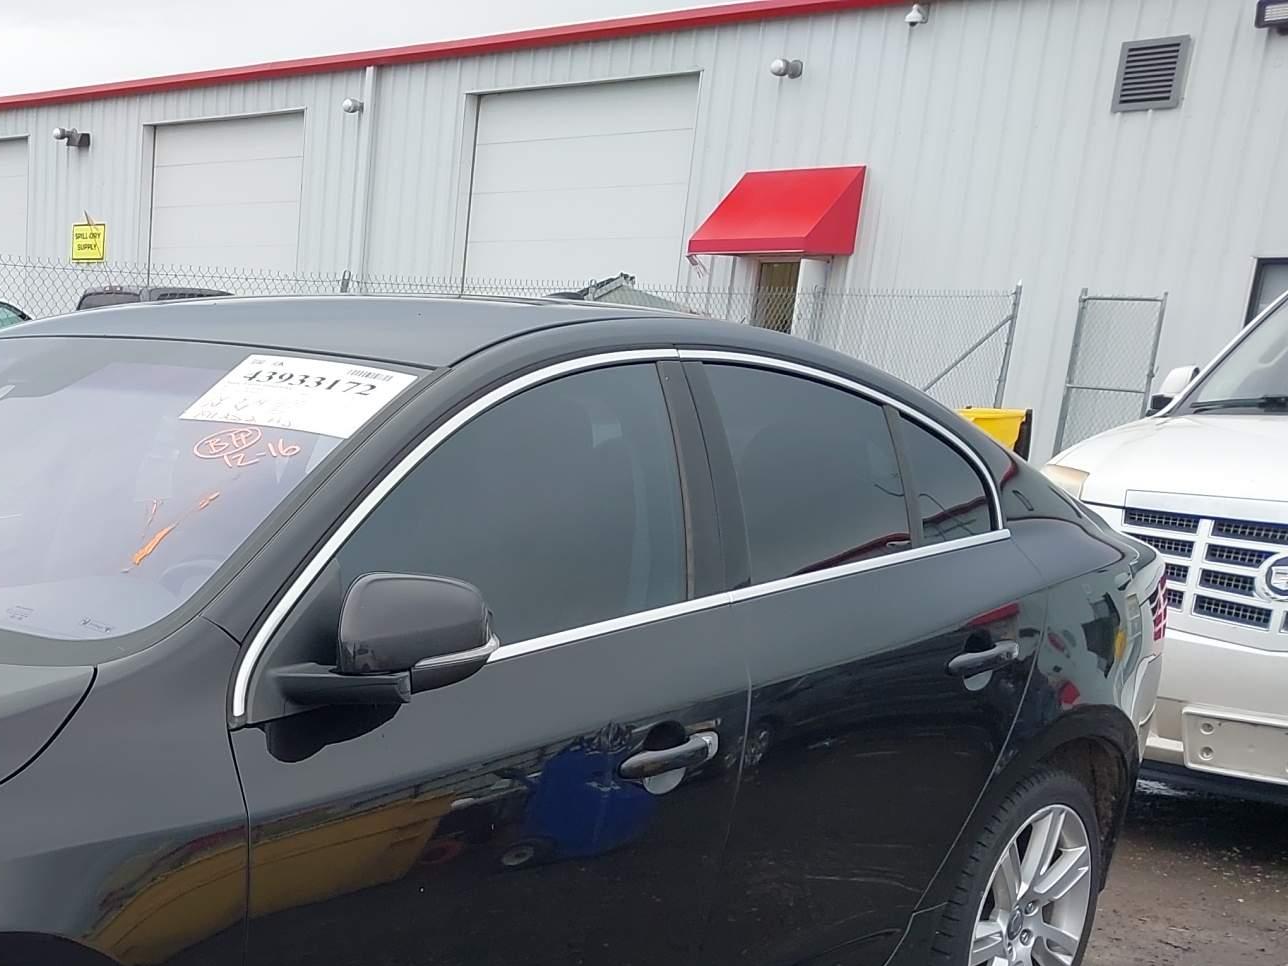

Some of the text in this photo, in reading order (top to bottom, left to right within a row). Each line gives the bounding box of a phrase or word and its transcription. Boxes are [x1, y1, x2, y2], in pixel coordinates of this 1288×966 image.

[77, 243, 97, 251] SUPPLY
[242, 368, 378, 397] 43933172
[223, 438, 302, 469] 12-16
